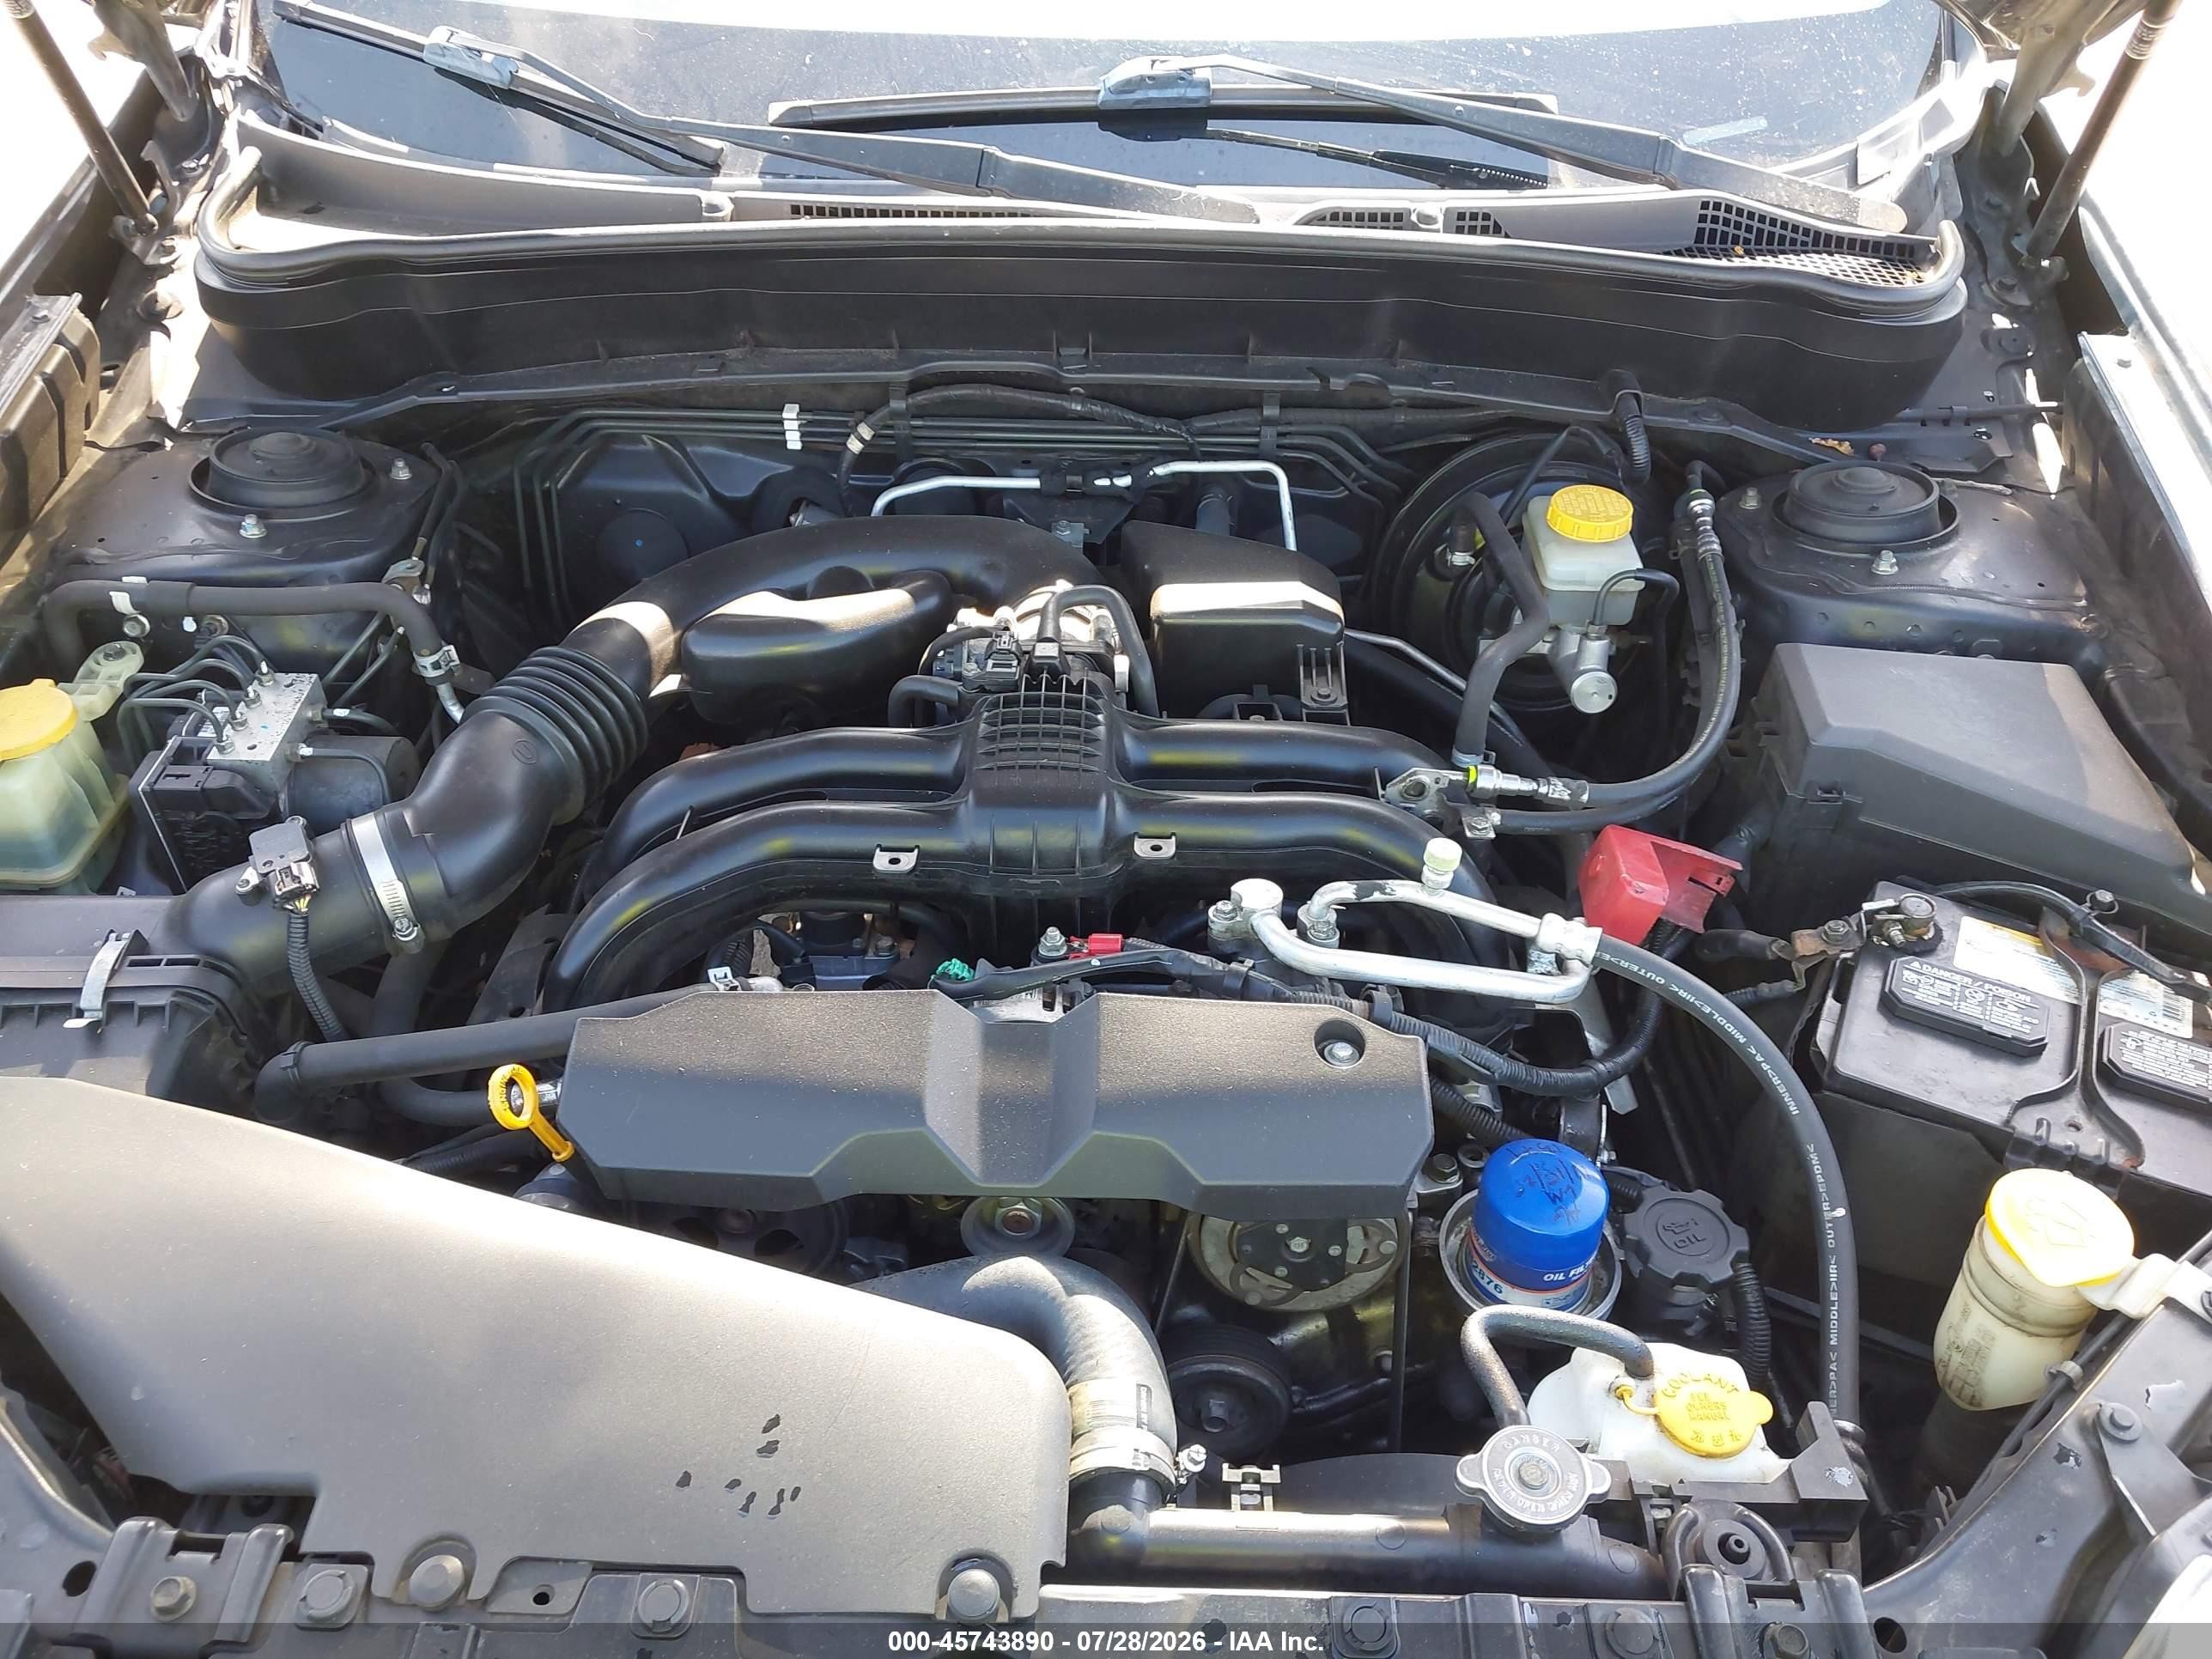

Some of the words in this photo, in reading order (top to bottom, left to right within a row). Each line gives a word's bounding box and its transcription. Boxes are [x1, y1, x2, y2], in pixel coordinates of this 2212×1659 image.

[1921, 963, 1973, 986] DANGER
[1984, 982, 2032, 1003] POISON
[1673, 1233, 1707, 1249] OIL
[1472, 1260, 1504, 1294] 2876
[1543, 1273, 1566, 1281] OIL
[1661, 1372, 1741, 1398] COOLANT
